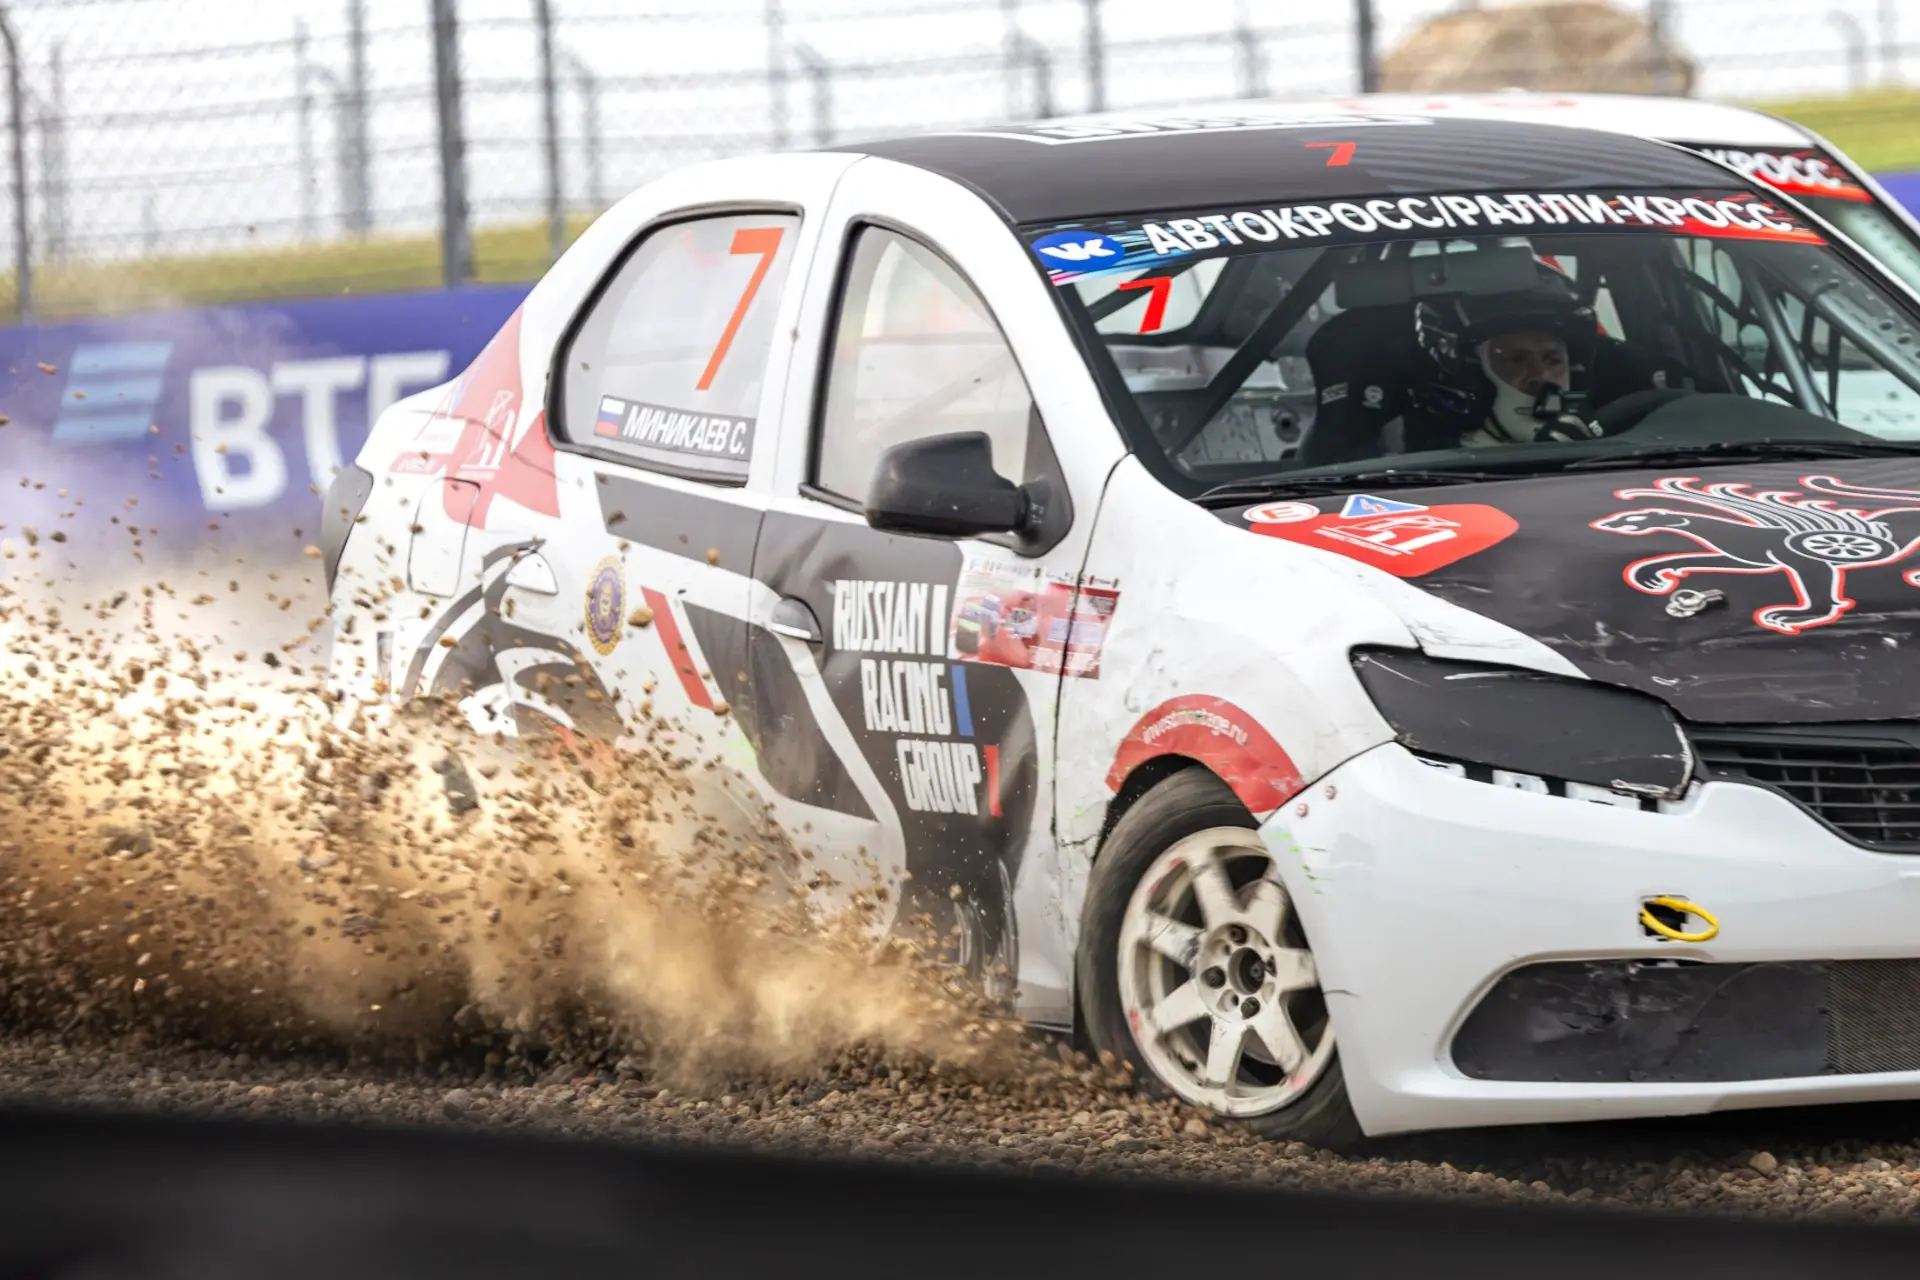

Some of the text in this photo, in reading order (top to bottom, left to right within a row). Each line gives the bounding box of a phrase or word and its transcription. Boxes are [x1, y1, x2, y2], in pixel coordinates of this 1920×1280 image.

[1303, 142, 1357, 167] 7
[1142, 193, 1793, 255] АВТОКРОСС/РАЛЛИ-КРОСС
[696, 228, 785, 390] 7
[1118, 276, 1172, 335] 7
[623, 404, 747, 455] МИНИКАЕВ С.
[832, 579, 929, 655] RUSSIAN
[861, 658, 951, 736] RACING
[896, 738, 982, 816] GROUP
